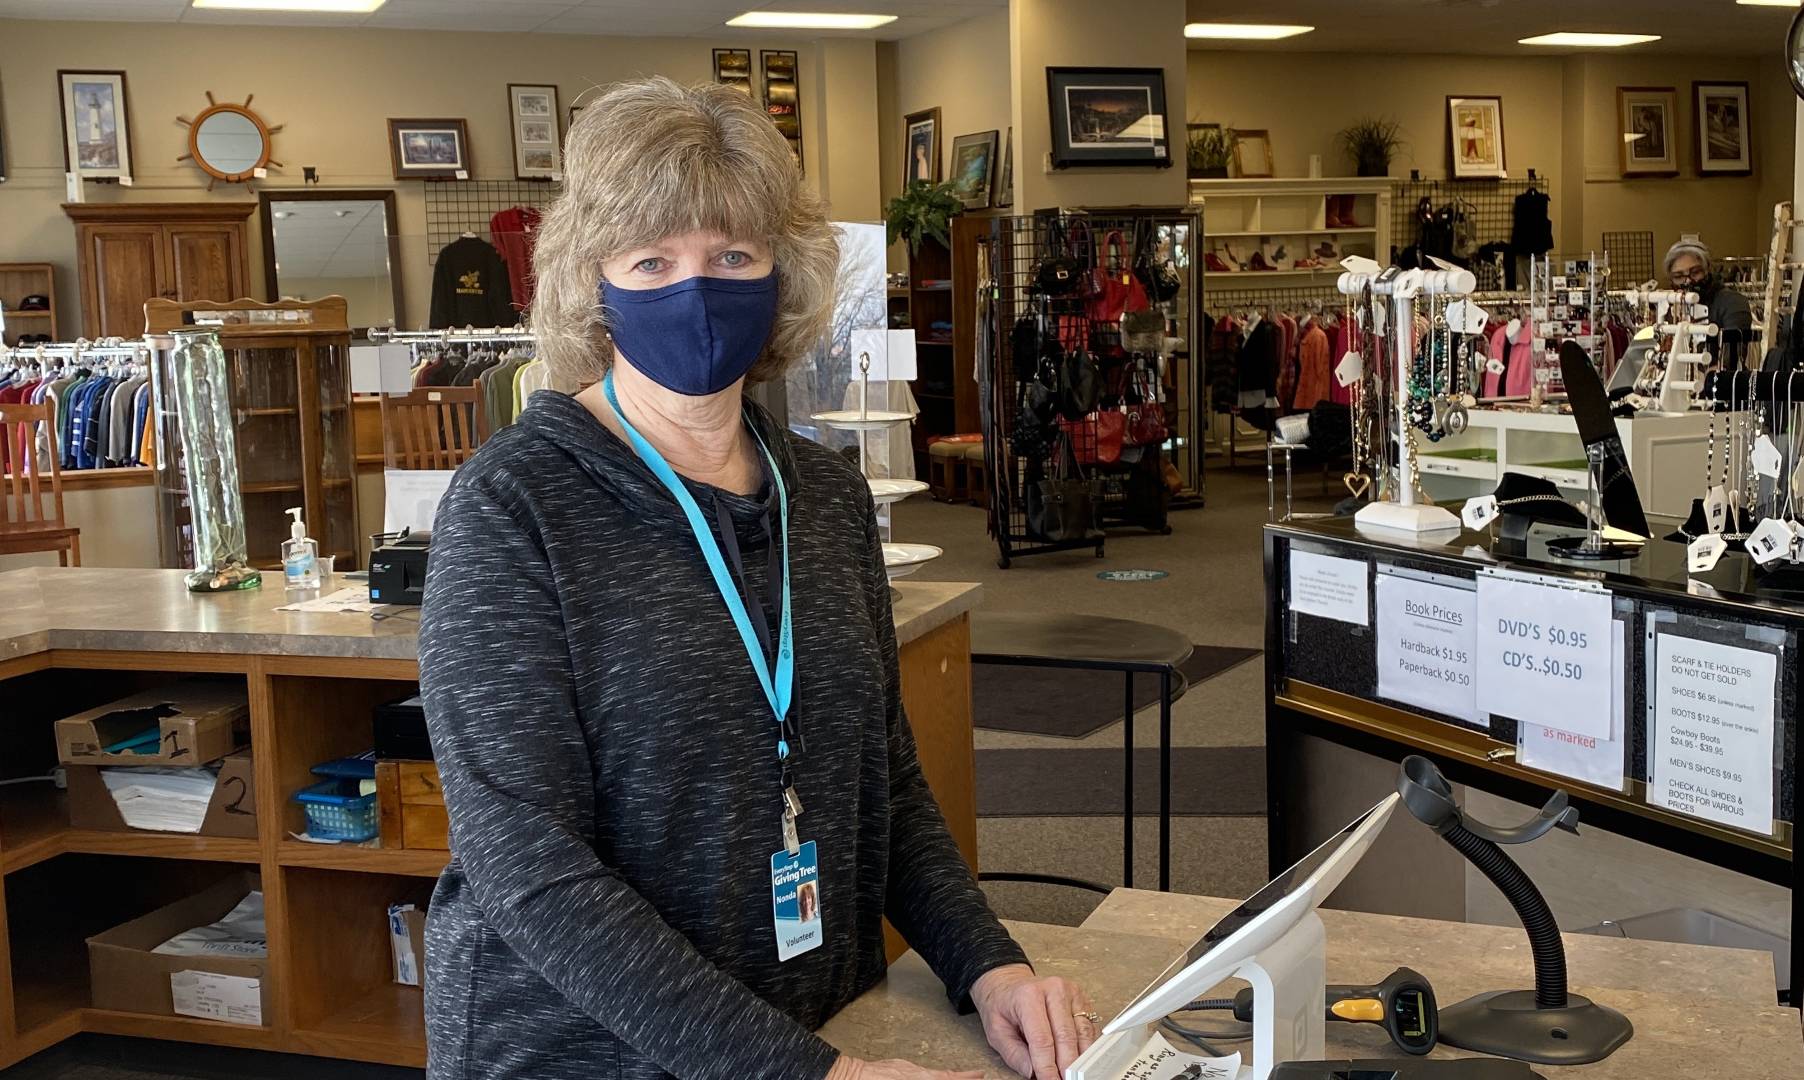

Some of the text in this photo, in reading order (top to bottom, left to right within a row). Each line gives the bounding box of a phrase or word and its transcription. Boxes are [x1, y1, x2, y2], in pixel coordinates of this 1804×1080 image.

[1406, 600, 1462, 623] Book Prices
[1498, 618, 1587, 648] DVD'S $0.95
[1400, 638, 1467, 663] Hardback $1.95
[1400, 658, 1470, 686] Paperback $0.50
[1672, 655, 1695, 666] SCARF
[1704, 661, 1714, 670] TIE
[1717, 664, 1751, 678] HOLDERS
[1685, 669, 1699, 677] NOT
[1701, 672, 1715, 680] GET
[1717, 675, 1737, 685] SOLD
[1672, 687, 1696, 698] SHOES
[1698, 692, 1716, 702] $6.95
[1672, 708, 1695, 719] BOOTS
[1698, 713, 1720, 725] $12.95
[164, 730, 189, 759] 1
[1544, 728, 1596, 748] as marked
[1671, 726, 1720, 744] Cowboy Boots
[1671, 736, 1693, 748] $24.95
[1700, 743, 1723, 756] $39.95
[1670, 758, 1742, 782] MEN'S SHOES $9.95
[224, 776, 256, 815] 2
[1669, 779, 1694, 792] CHECK
[1696, 786, 1709, 796] ALL
[1711, 790, 1736, 803] SHOES
[1668, 800, 1694, 813] PRICES
[1669, 790, 1744, 816] BOOTS FOR VARIOUS
[776, 891, 796, 904] Nonda
[786, 931, 814, 948] Volunteer
